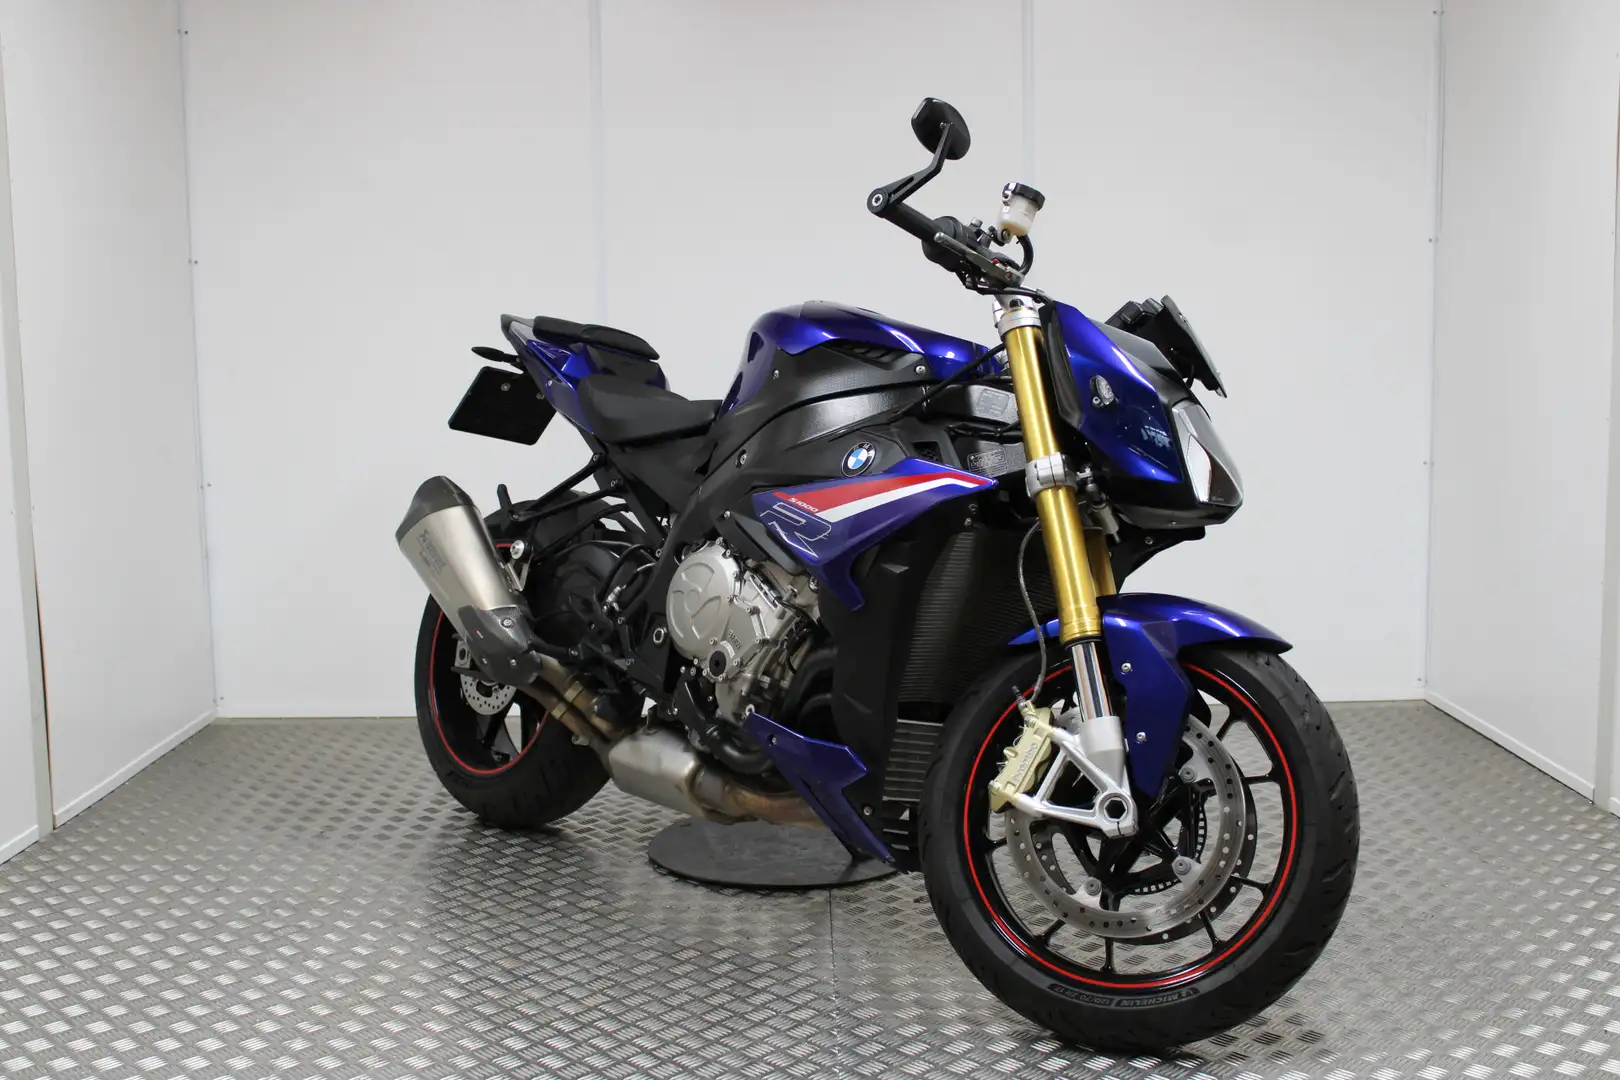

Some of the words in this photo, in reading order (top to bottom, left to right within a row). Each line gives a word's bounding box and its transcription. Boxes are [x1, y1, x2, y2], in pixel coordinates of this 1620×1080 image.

[789, 498, 819, 513] S1000
[760, 502, 831, 559] R
[1120, 993, 1179, 1006] MICHELIN
